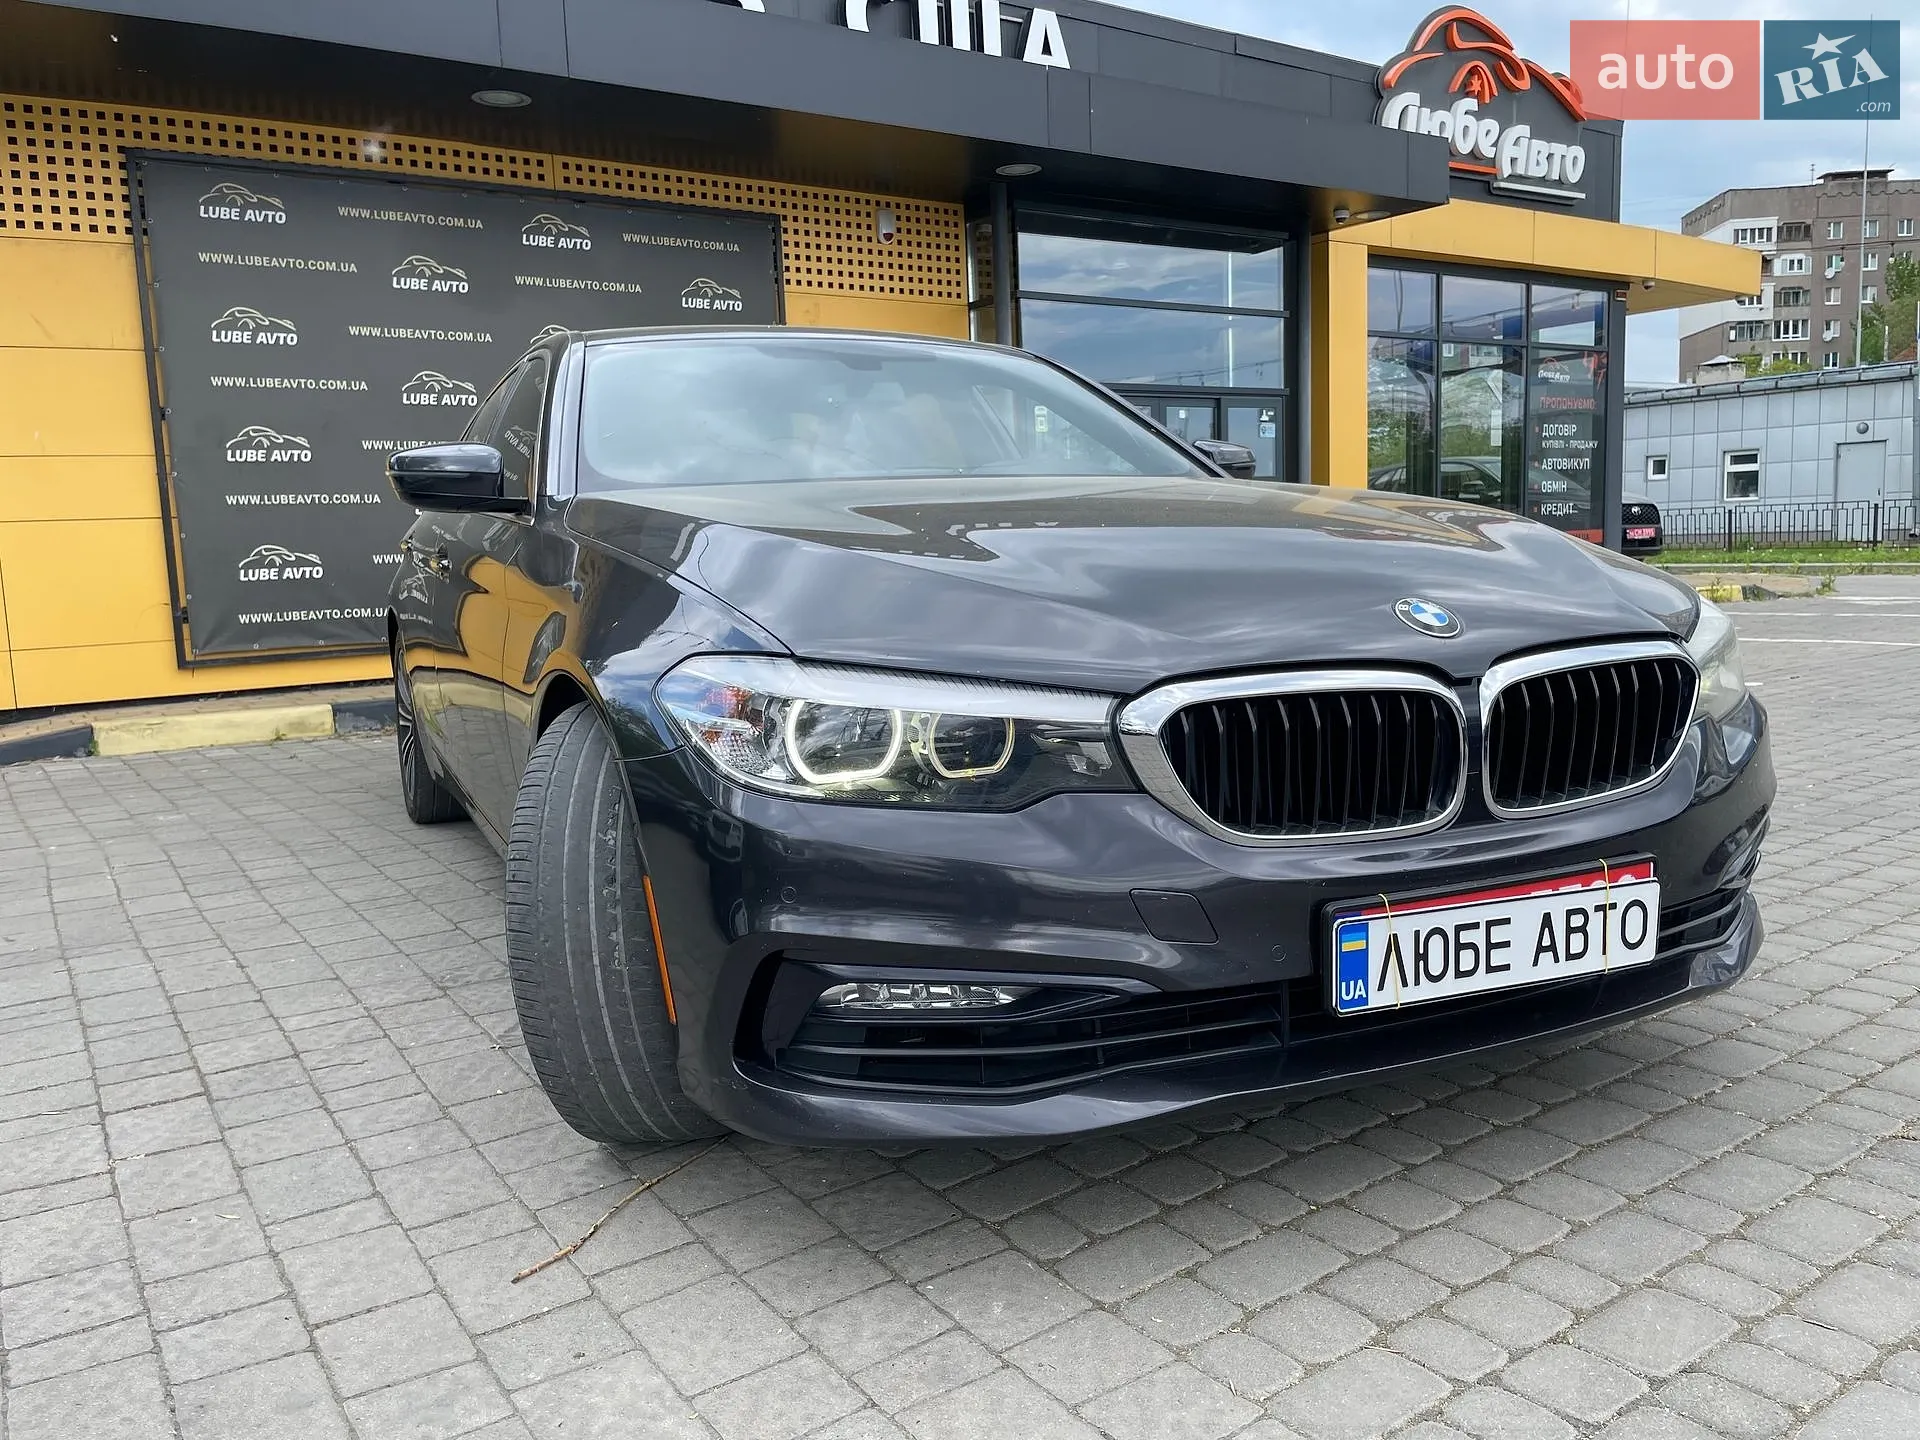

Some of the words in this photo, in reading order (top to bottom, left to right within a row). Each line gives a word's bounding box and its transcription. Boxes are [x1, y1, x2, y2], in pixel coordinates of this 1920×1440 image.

[199, 204, 241, 221] LUBE
[244, 209, 287, 224] AVTO
[337, 206, 484, 229] WWW.LUBEAVTO.COM.UA
[522, 233, 555, 248] LUBE
[557, 237, 592, 251] AVTO
[622, 233, 740, 252] WWW.LUBEAVTO.COM.UA
[198, 252, 358, 273] WWW.LUBEAVTO.COM.UA
[392, 276, 428, 291] LUBE
[431, 280, 469, 294] AVTO
[514, 275, 642, 293] WWW.LUBEAVTO.COM.UA
[681, 296, 711, 310] LUBE
[712, 299, 743, 312] AVTO
[211, 330, 252, 344] LUBE
[255, 332, 298, 345] AVTO
[348, 325, 493, 342] WWW.LUBEAVTO.COM.UA
[210, 376, 368, 391] WWW.LUBEAVTO.COM.UA
[402, 393, 438, 406] LUBE
[441, 394, 478, 407] AVTO
[1542, 423, 1577, 438] ДОГОВІР
[226, 450, 267, 462] LUBE
[270, 450, 312, 463] AVTO
[1541, 458, 1590, 470] АВТОВИКУП
[1541, 481, 1568, 493] ОБМІН
[225, 494, 381, 505] WWW.LUBEAVTO.COM.UA
[239, 568, 278, 581] LUBE
[282, 566, 323, 580] AVTO
[1341, 980, 1367, 1001] UA
[1377, 917, 1512, 992] ЛЮБЕ
[1532, 899, 1649, 968] АВТО
